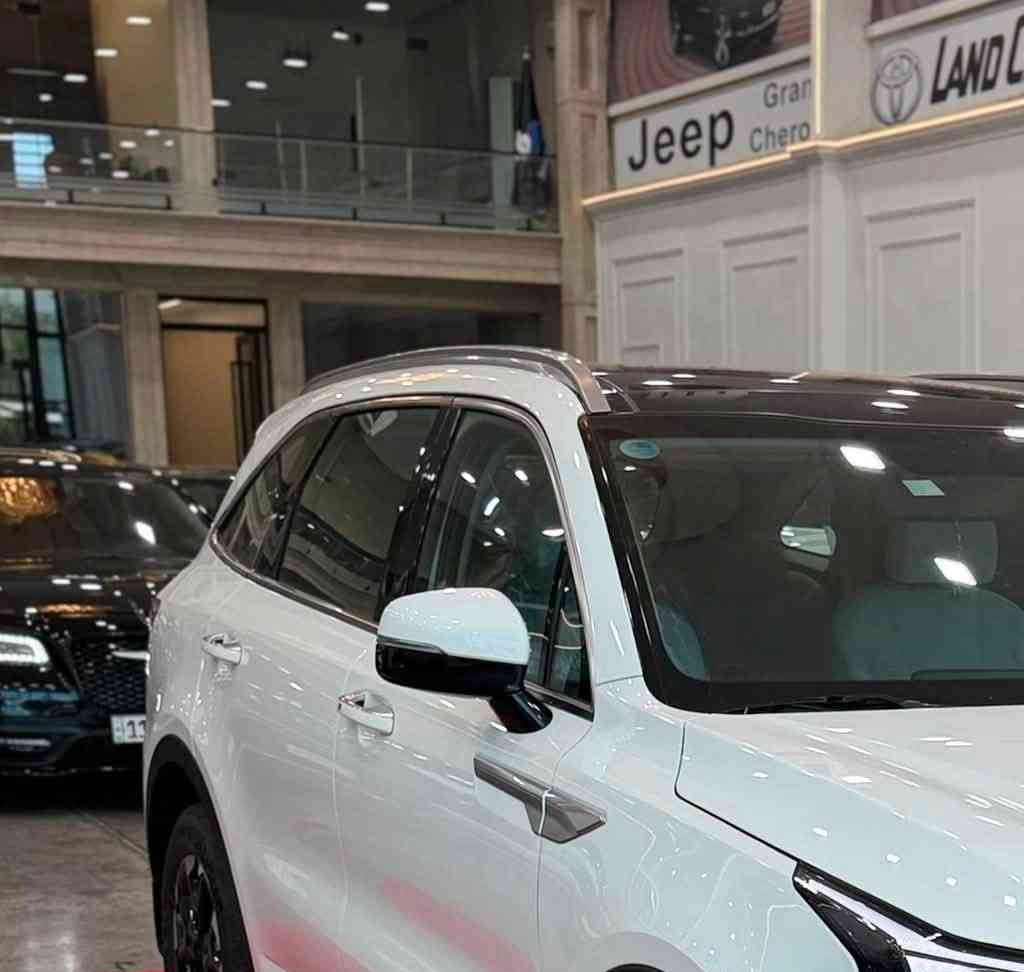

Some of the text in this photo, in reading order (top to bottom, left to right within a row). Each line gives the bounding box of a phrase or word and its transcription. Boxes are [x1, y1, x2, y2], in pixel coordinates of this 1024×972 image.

[930, 34, 1004, 105] LAND
[628, 109, 735, 172] Jeep
[750, 121, 811, 153] Chero
